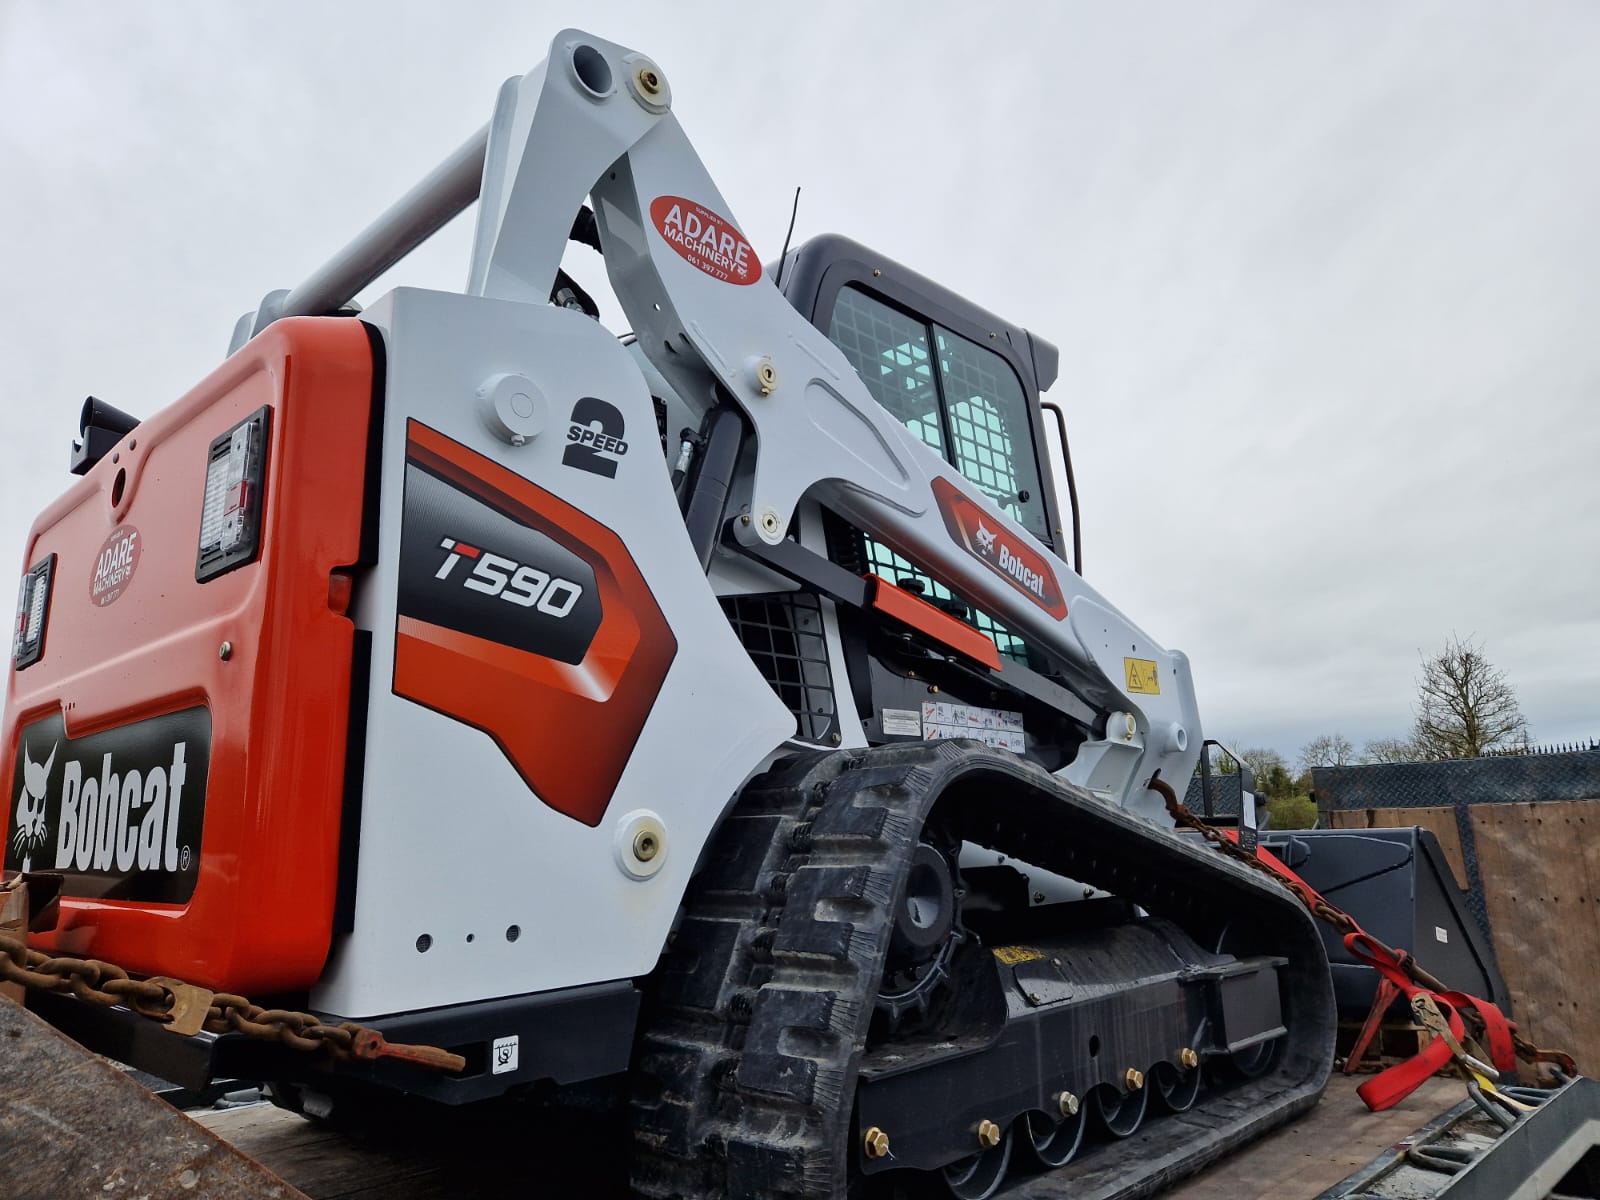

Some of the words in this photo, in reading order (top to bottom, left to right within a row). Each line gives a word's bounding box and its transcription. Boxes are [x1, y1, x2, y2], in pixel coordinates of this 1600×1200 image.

[663, 224, 737, 272] MACHINERY
[664, 204, 750, 266] ADARE
[687, 254, 700, 266] 061
[716, 269, 729, 280] 777
[562, 396, 625, 479] 2
[566, 425, 629, 456] SPEED
[93, 568, 127, 597] MACHINERY
[94, 531, 137, 582] ADARE
[435, 538, 583, 618] T590
[998, 544, 1044, 597] Bobcat
[55, 741, 187, 873] Bobcat
